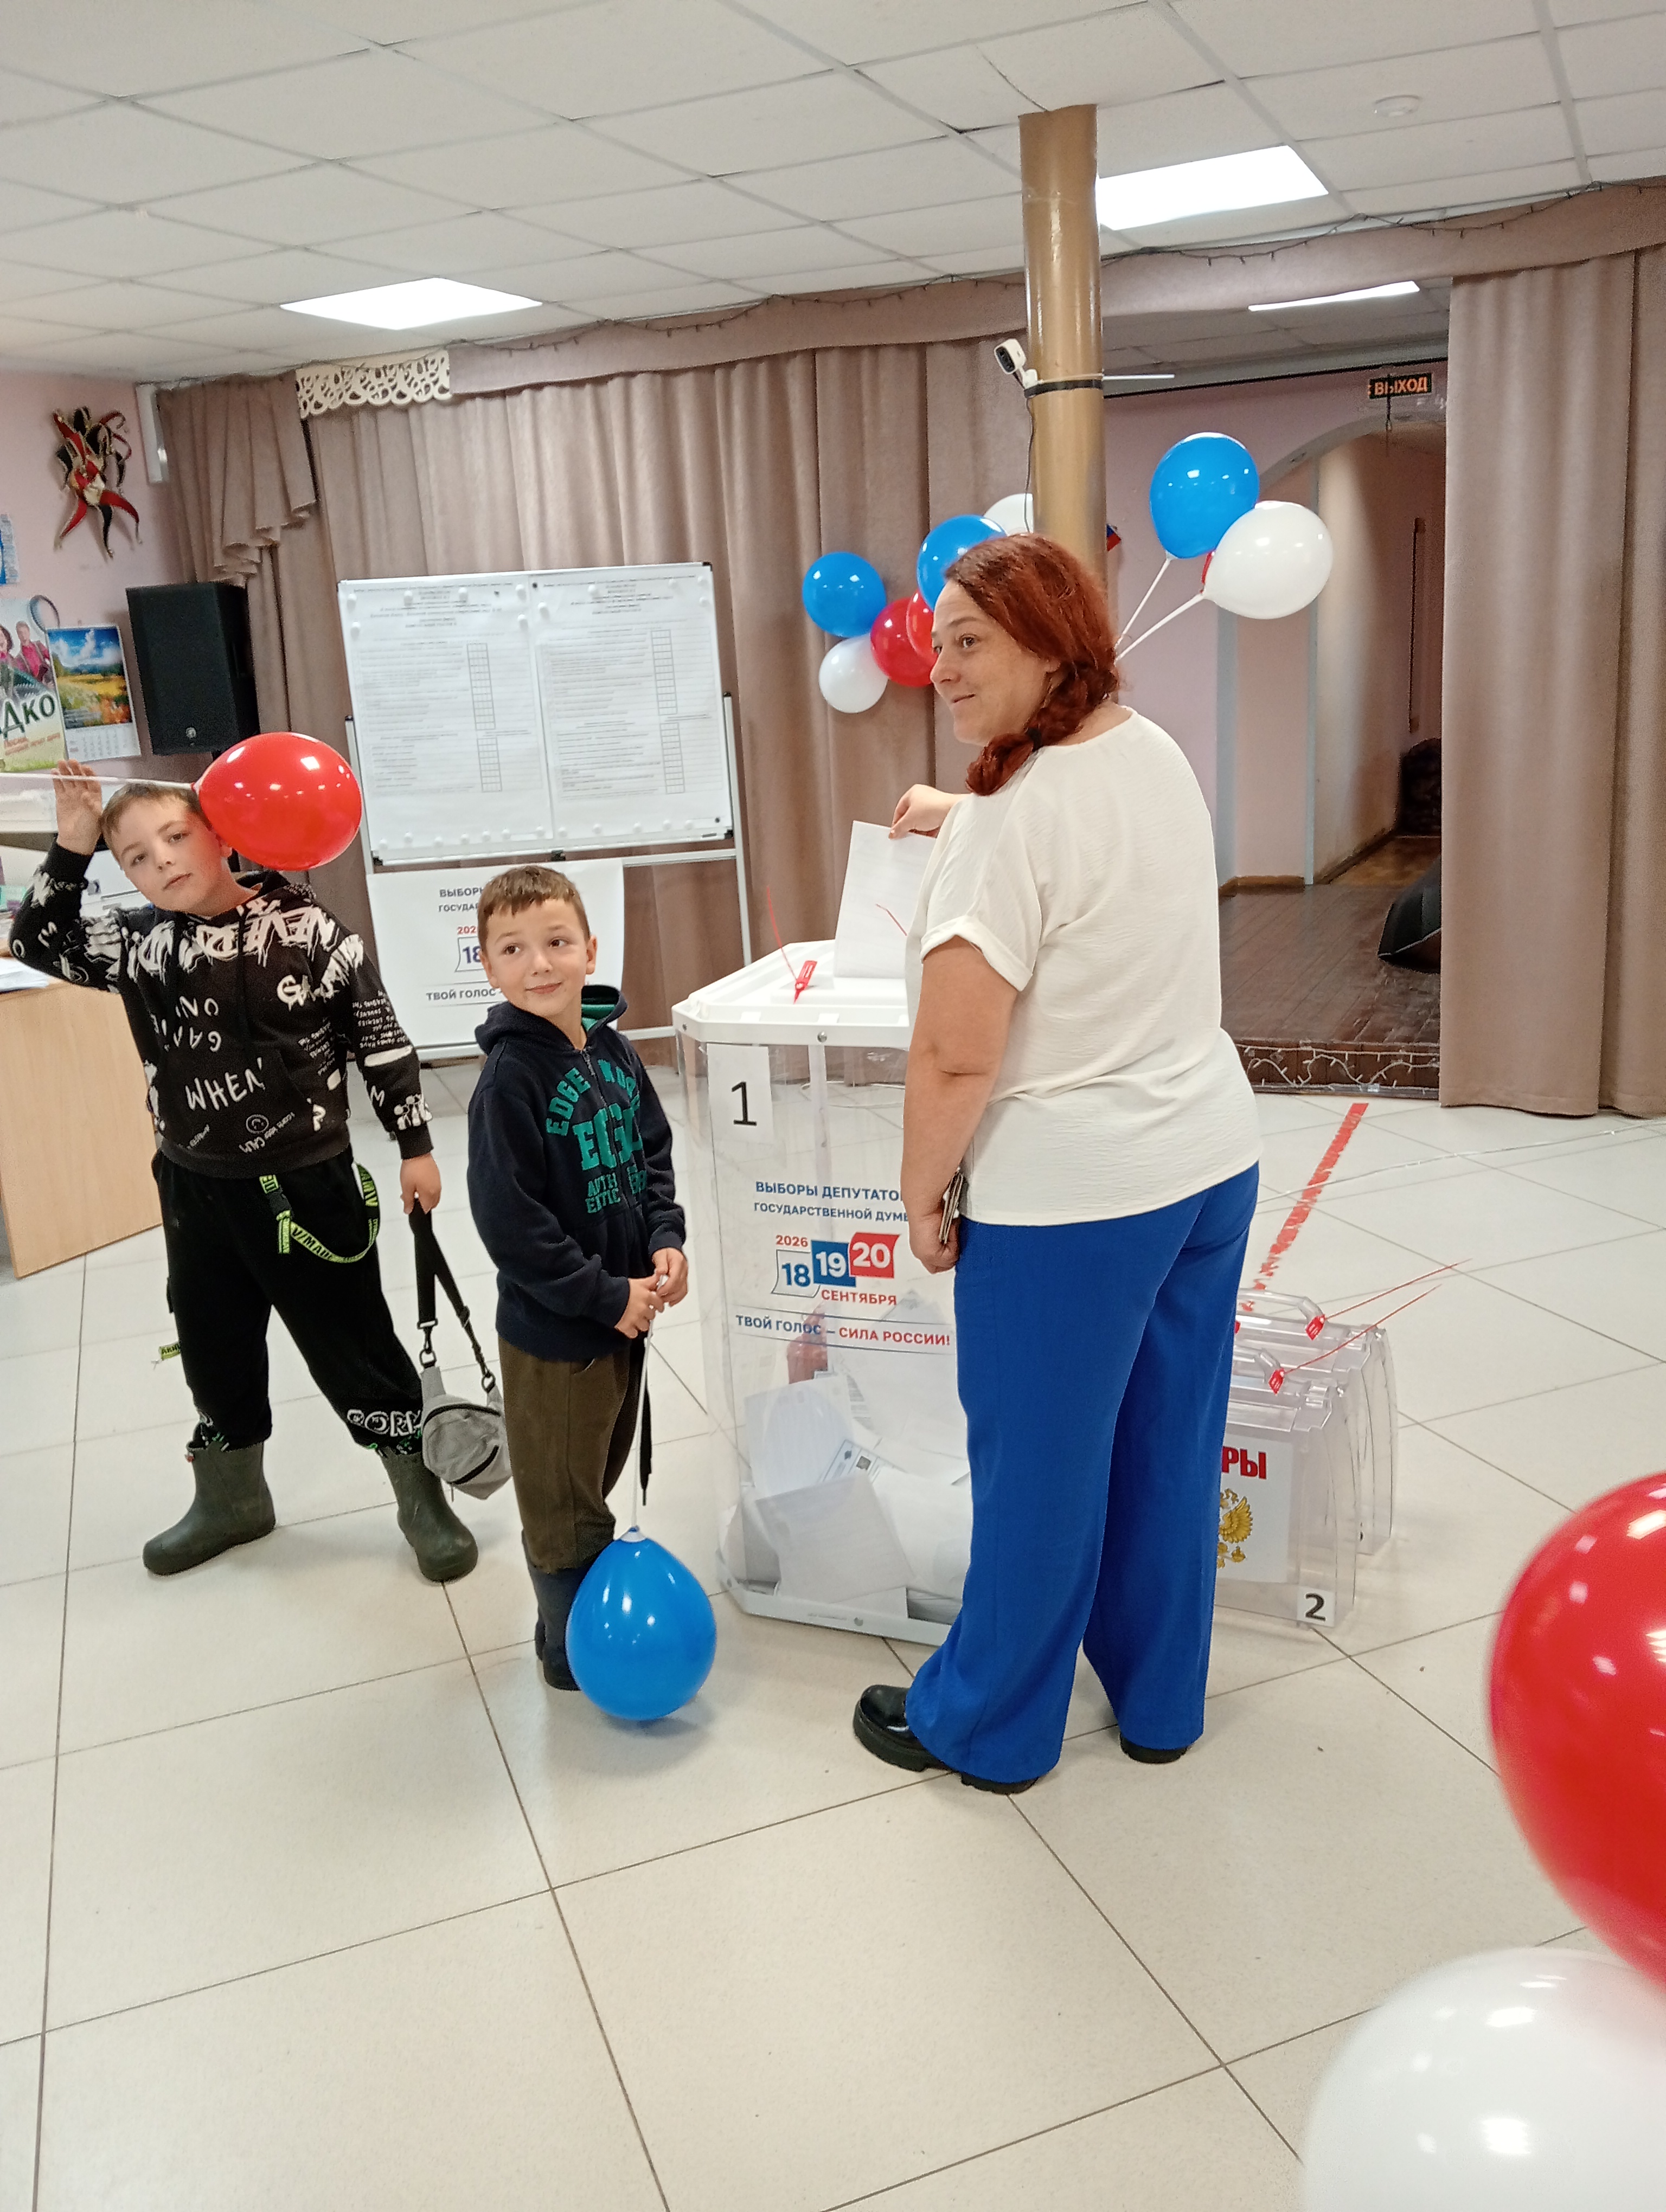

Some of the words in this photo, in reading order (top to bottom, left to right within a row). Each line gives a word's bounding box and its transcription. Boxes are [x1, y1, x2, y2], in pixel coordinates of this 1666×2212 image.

[1374, 377, 1427, 395] ВЫХОД
[457, 925, 477, 935] 202
[426, 989, 457, 1000] ТВОЙ
[459, 988, 496, 999] ГОЛОС
[731, 1081, 758, 1127] 1
[756, 1181, 818, 1197] ВЫБОРЫ
[822, 1185, 902, 1201] ДЕПУТАТО
[754, 1201, 873, 1220] ГОСУДАРСТВЕННОЙ
[776, 1234, 808, 1248] 2026
[781, 1263, 810, 1287] 18
[815, 1251, 847, 1278] 19
[852, 1242, 890, 1269] 20
[821, 1289, 897, 1306] СЕНТЯБРЯ
[736, 1315, 772, 1329] ТВОЙ
[776, 1320, 821, 1335] ГОЛОС
[838, 1327, 879, 1341] СИЛА
[883, 1331, 950, 1347] РОССИИ!
[1222, 1446, 1266, 1480] РЫ
[1305, 1593, 1327, 1622] 2
